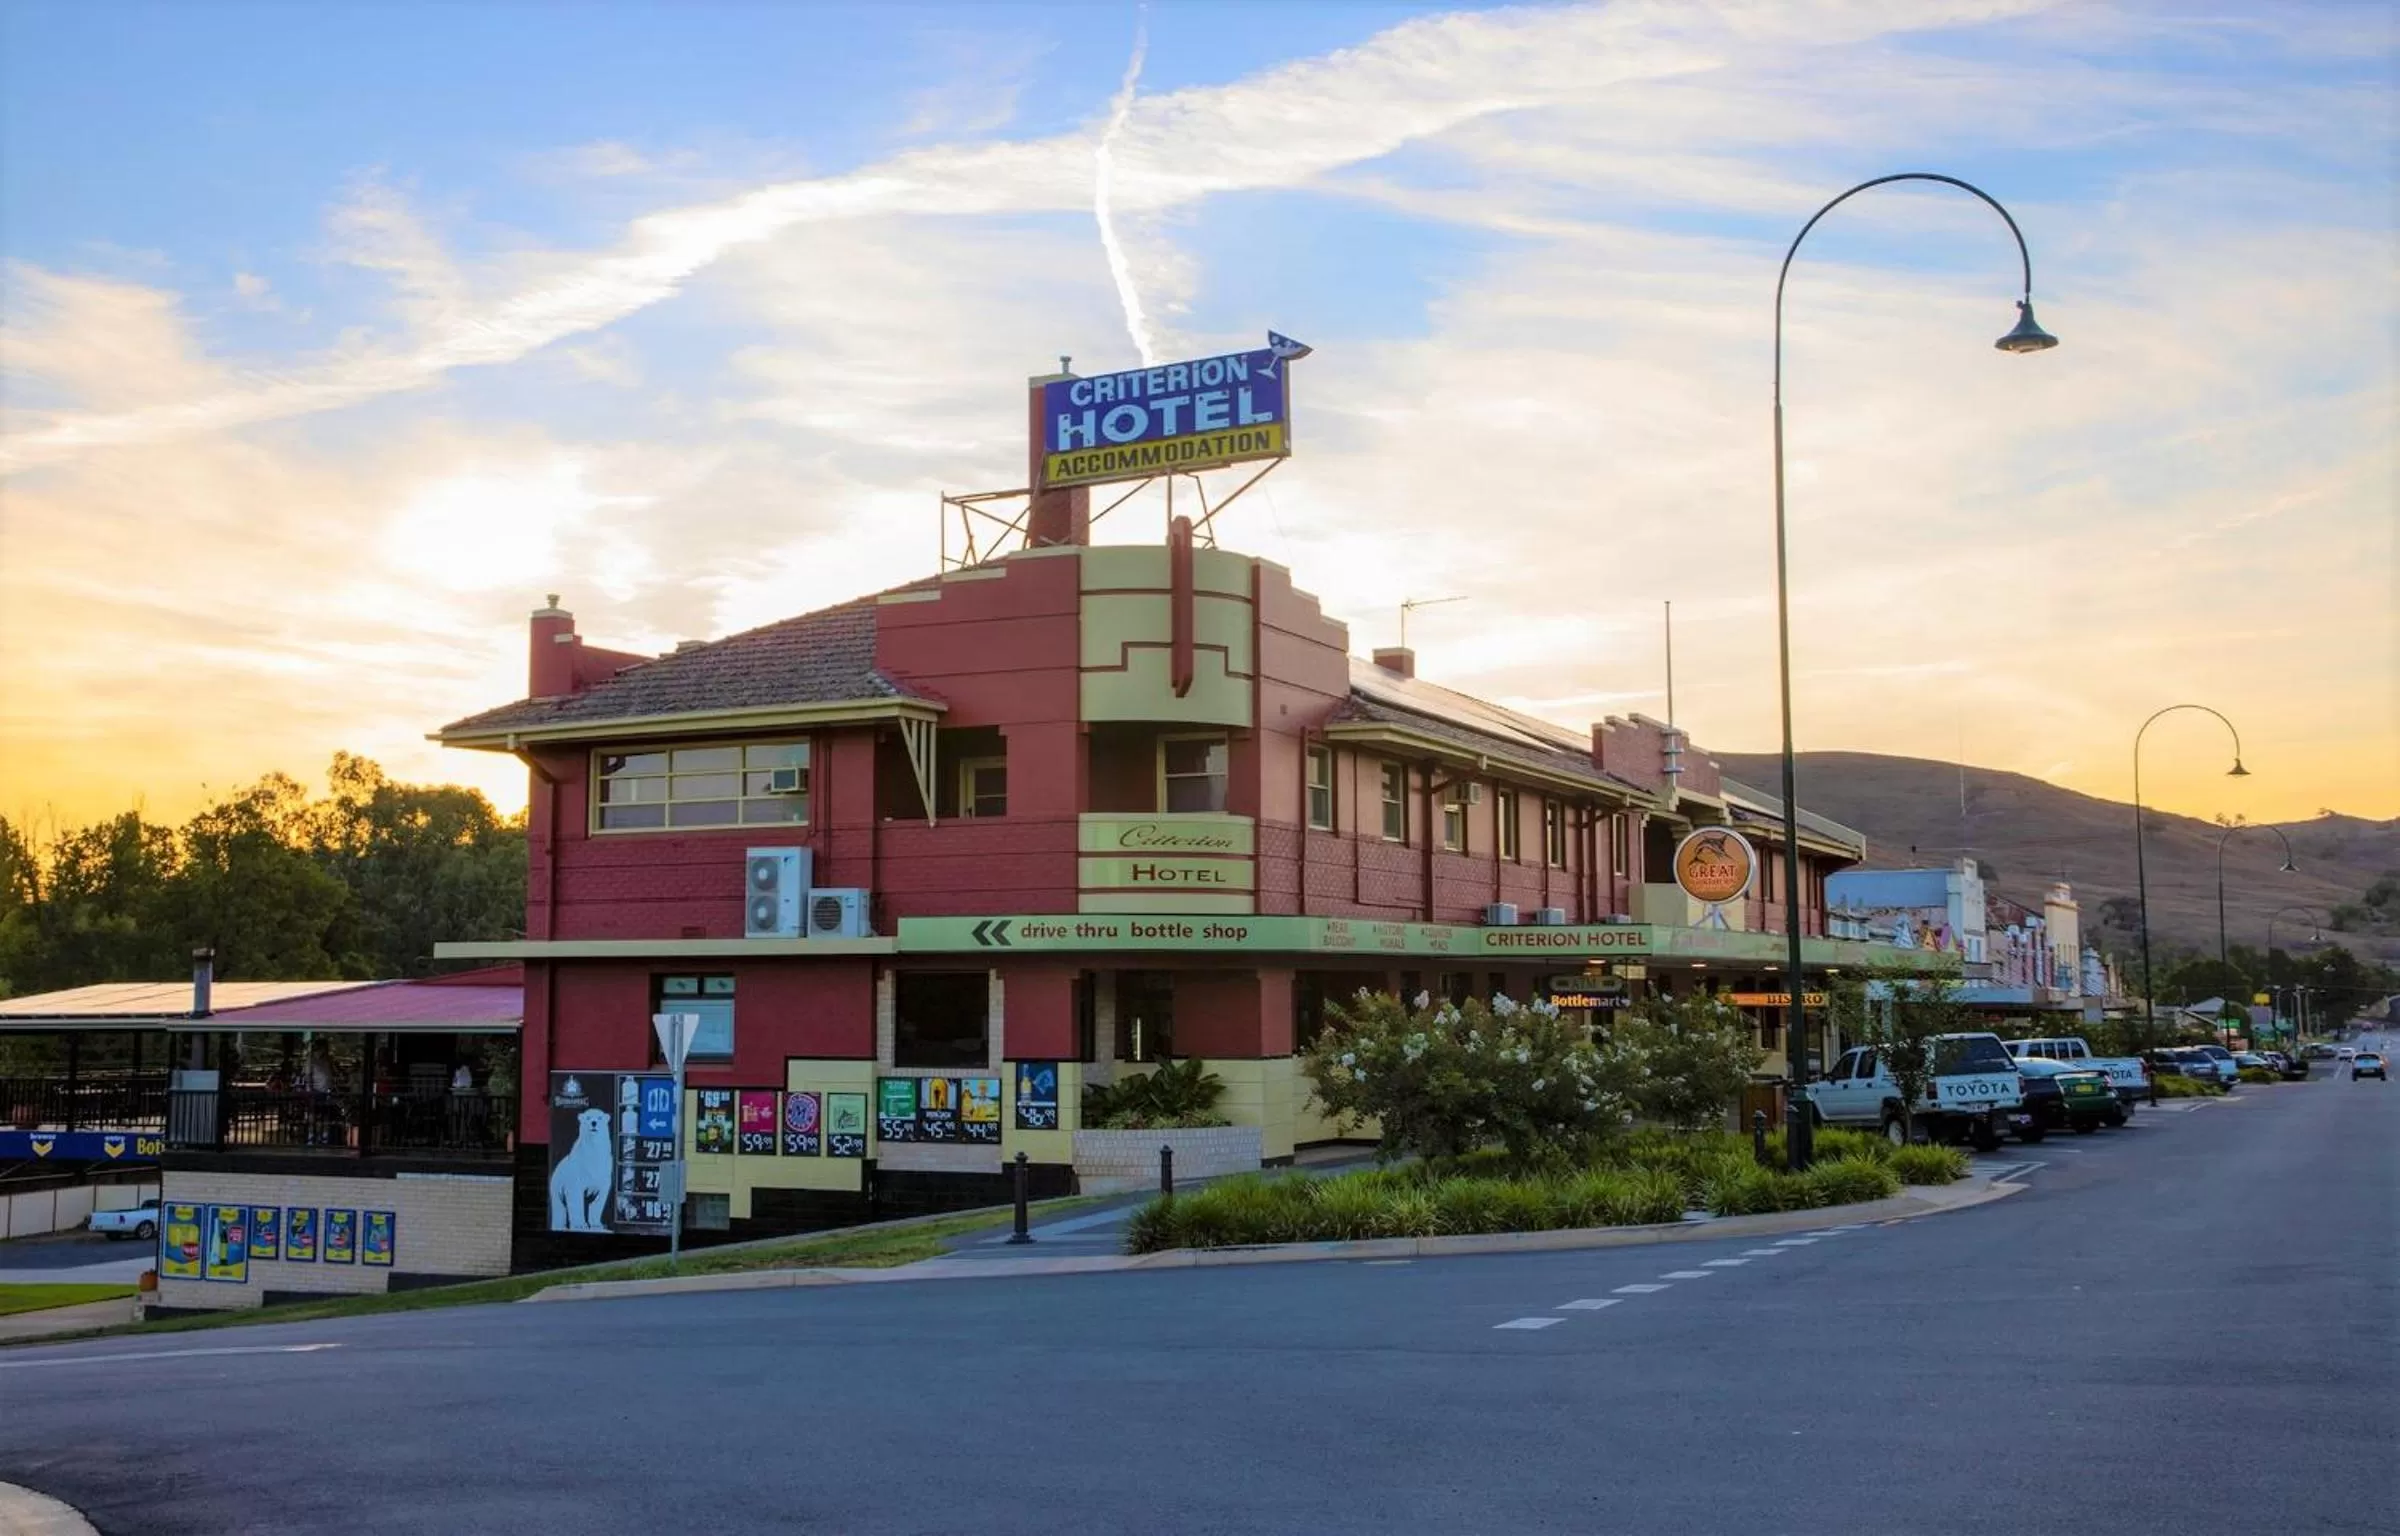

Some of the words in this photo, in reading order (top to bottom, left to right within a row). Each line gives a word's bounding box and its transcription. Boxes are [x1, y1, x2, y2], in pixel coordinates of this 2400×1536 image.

[1069, 355, 1249, 406] CRITERION
[1057, 386, 1273, 452] HOTEL
[1056, 430, 1271, 477] ACCOMMODATION
[1119, 824, 1233, 848] Criterion
[1689, 864, 1735, 878] GREAT
[1020, 923, 1068, 939] drive
[1074, 922, 1118, 939] thru
[1130, 921, 1193, 939] bottle
[1202, 922, 1248, 942] shop
[1486, 932, 1581, 947] CRITERION
[1587, 932, 1647, 947] HOTEL
[1767, 994, 1824, 1005] BISRO
[1946, 1083, 2010, 1097] TOYOTA
[136, 1137, 165, 1155] Bot
